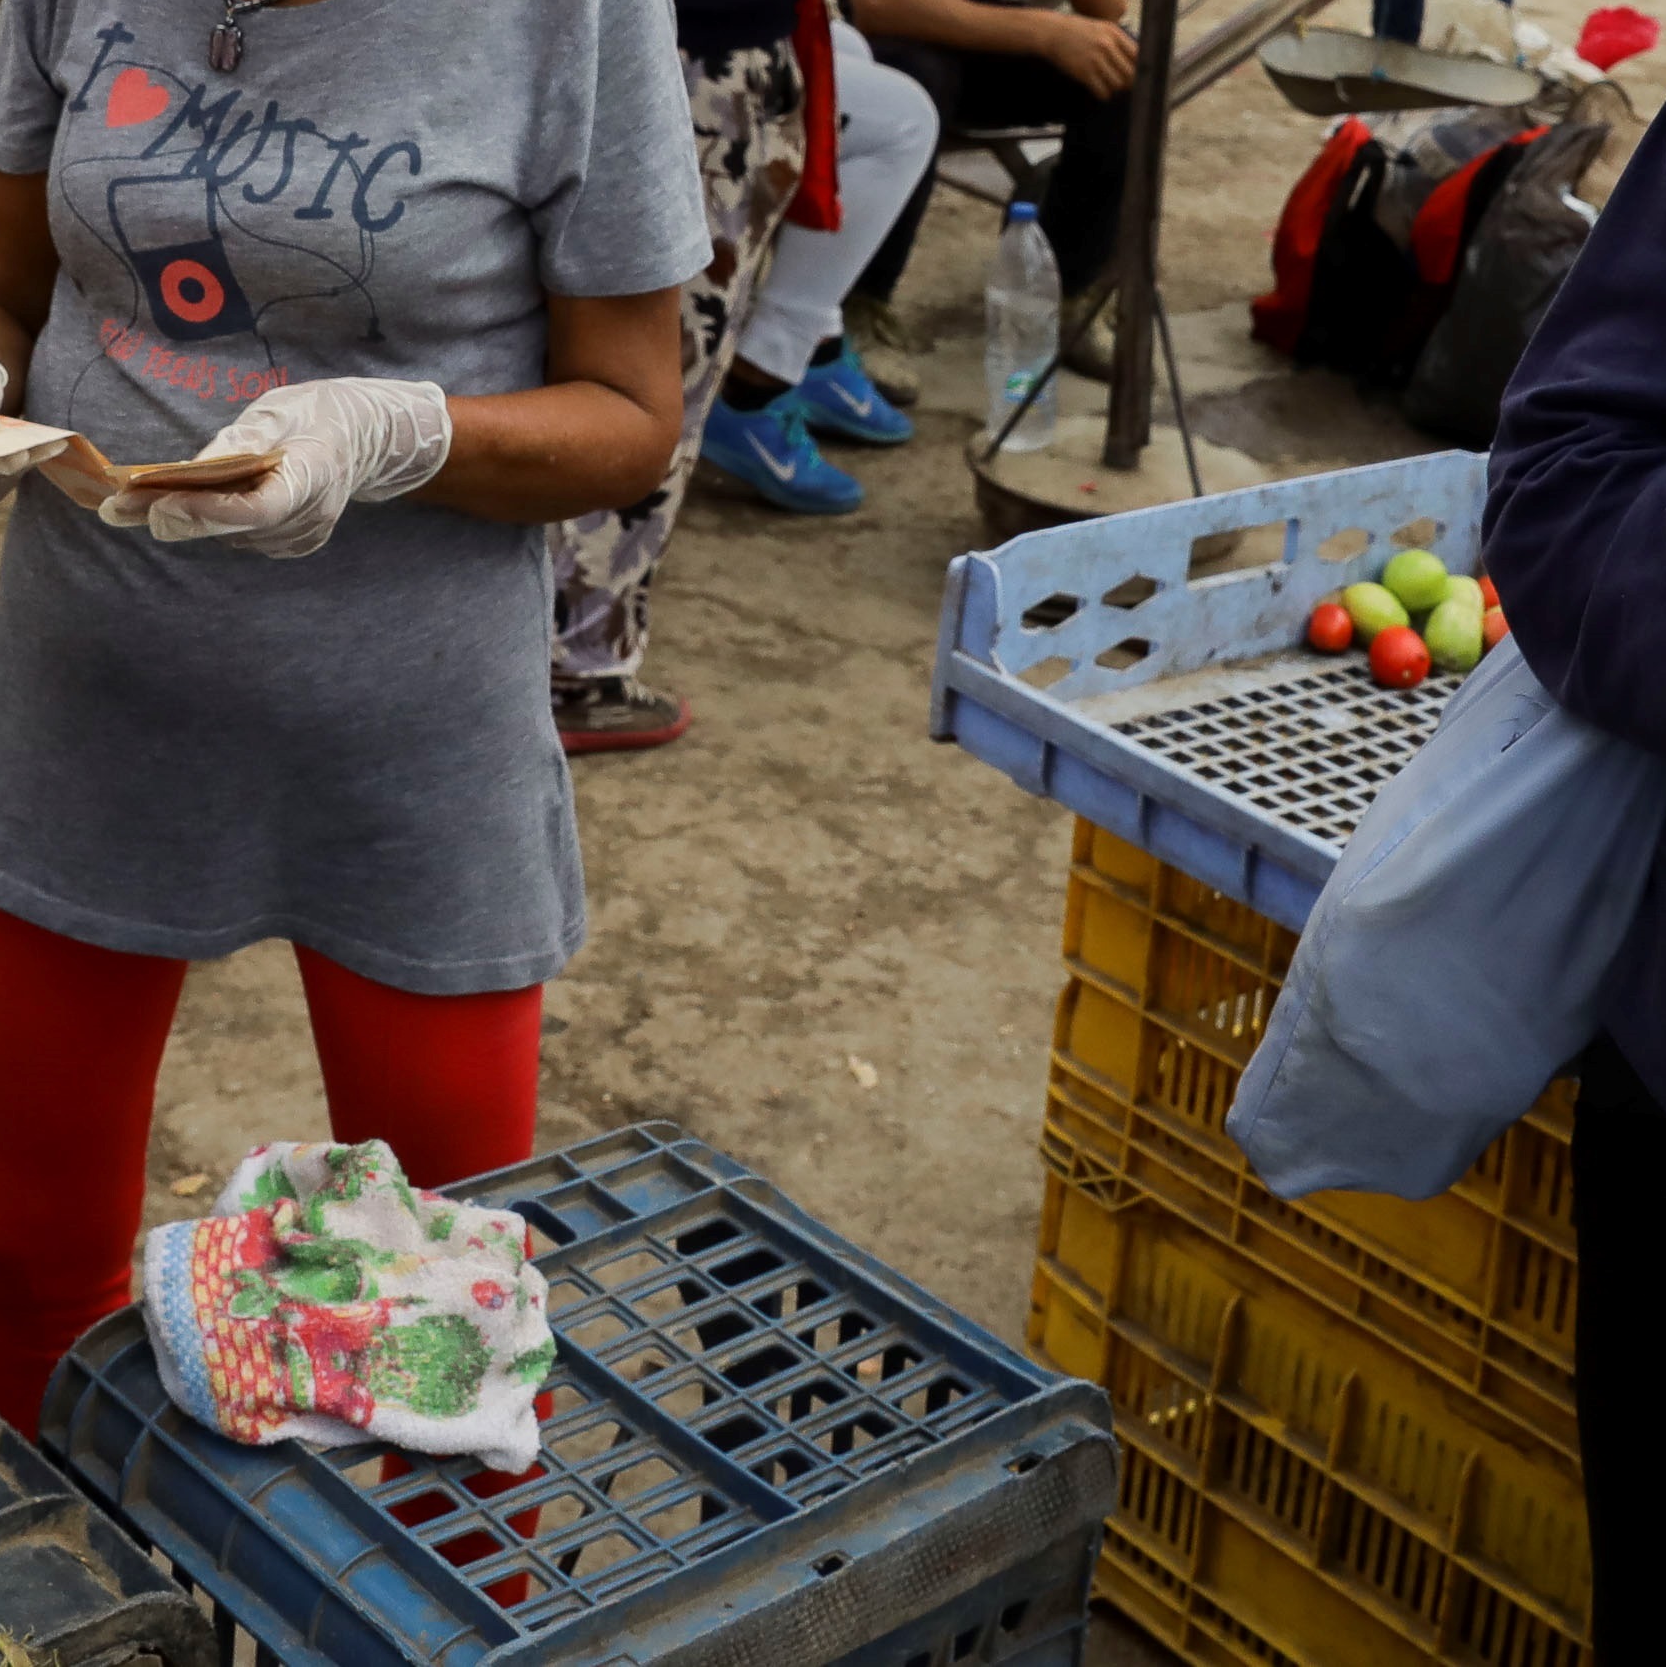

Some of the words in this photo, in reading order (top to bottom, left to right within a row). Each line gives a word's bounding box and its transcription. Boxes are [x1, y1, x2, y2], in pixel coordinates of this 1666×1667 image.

[68, 22, 136, 112] I
[140, 83, 423, 233] MUSIC
[143, 345, 218, 401] TEENS
